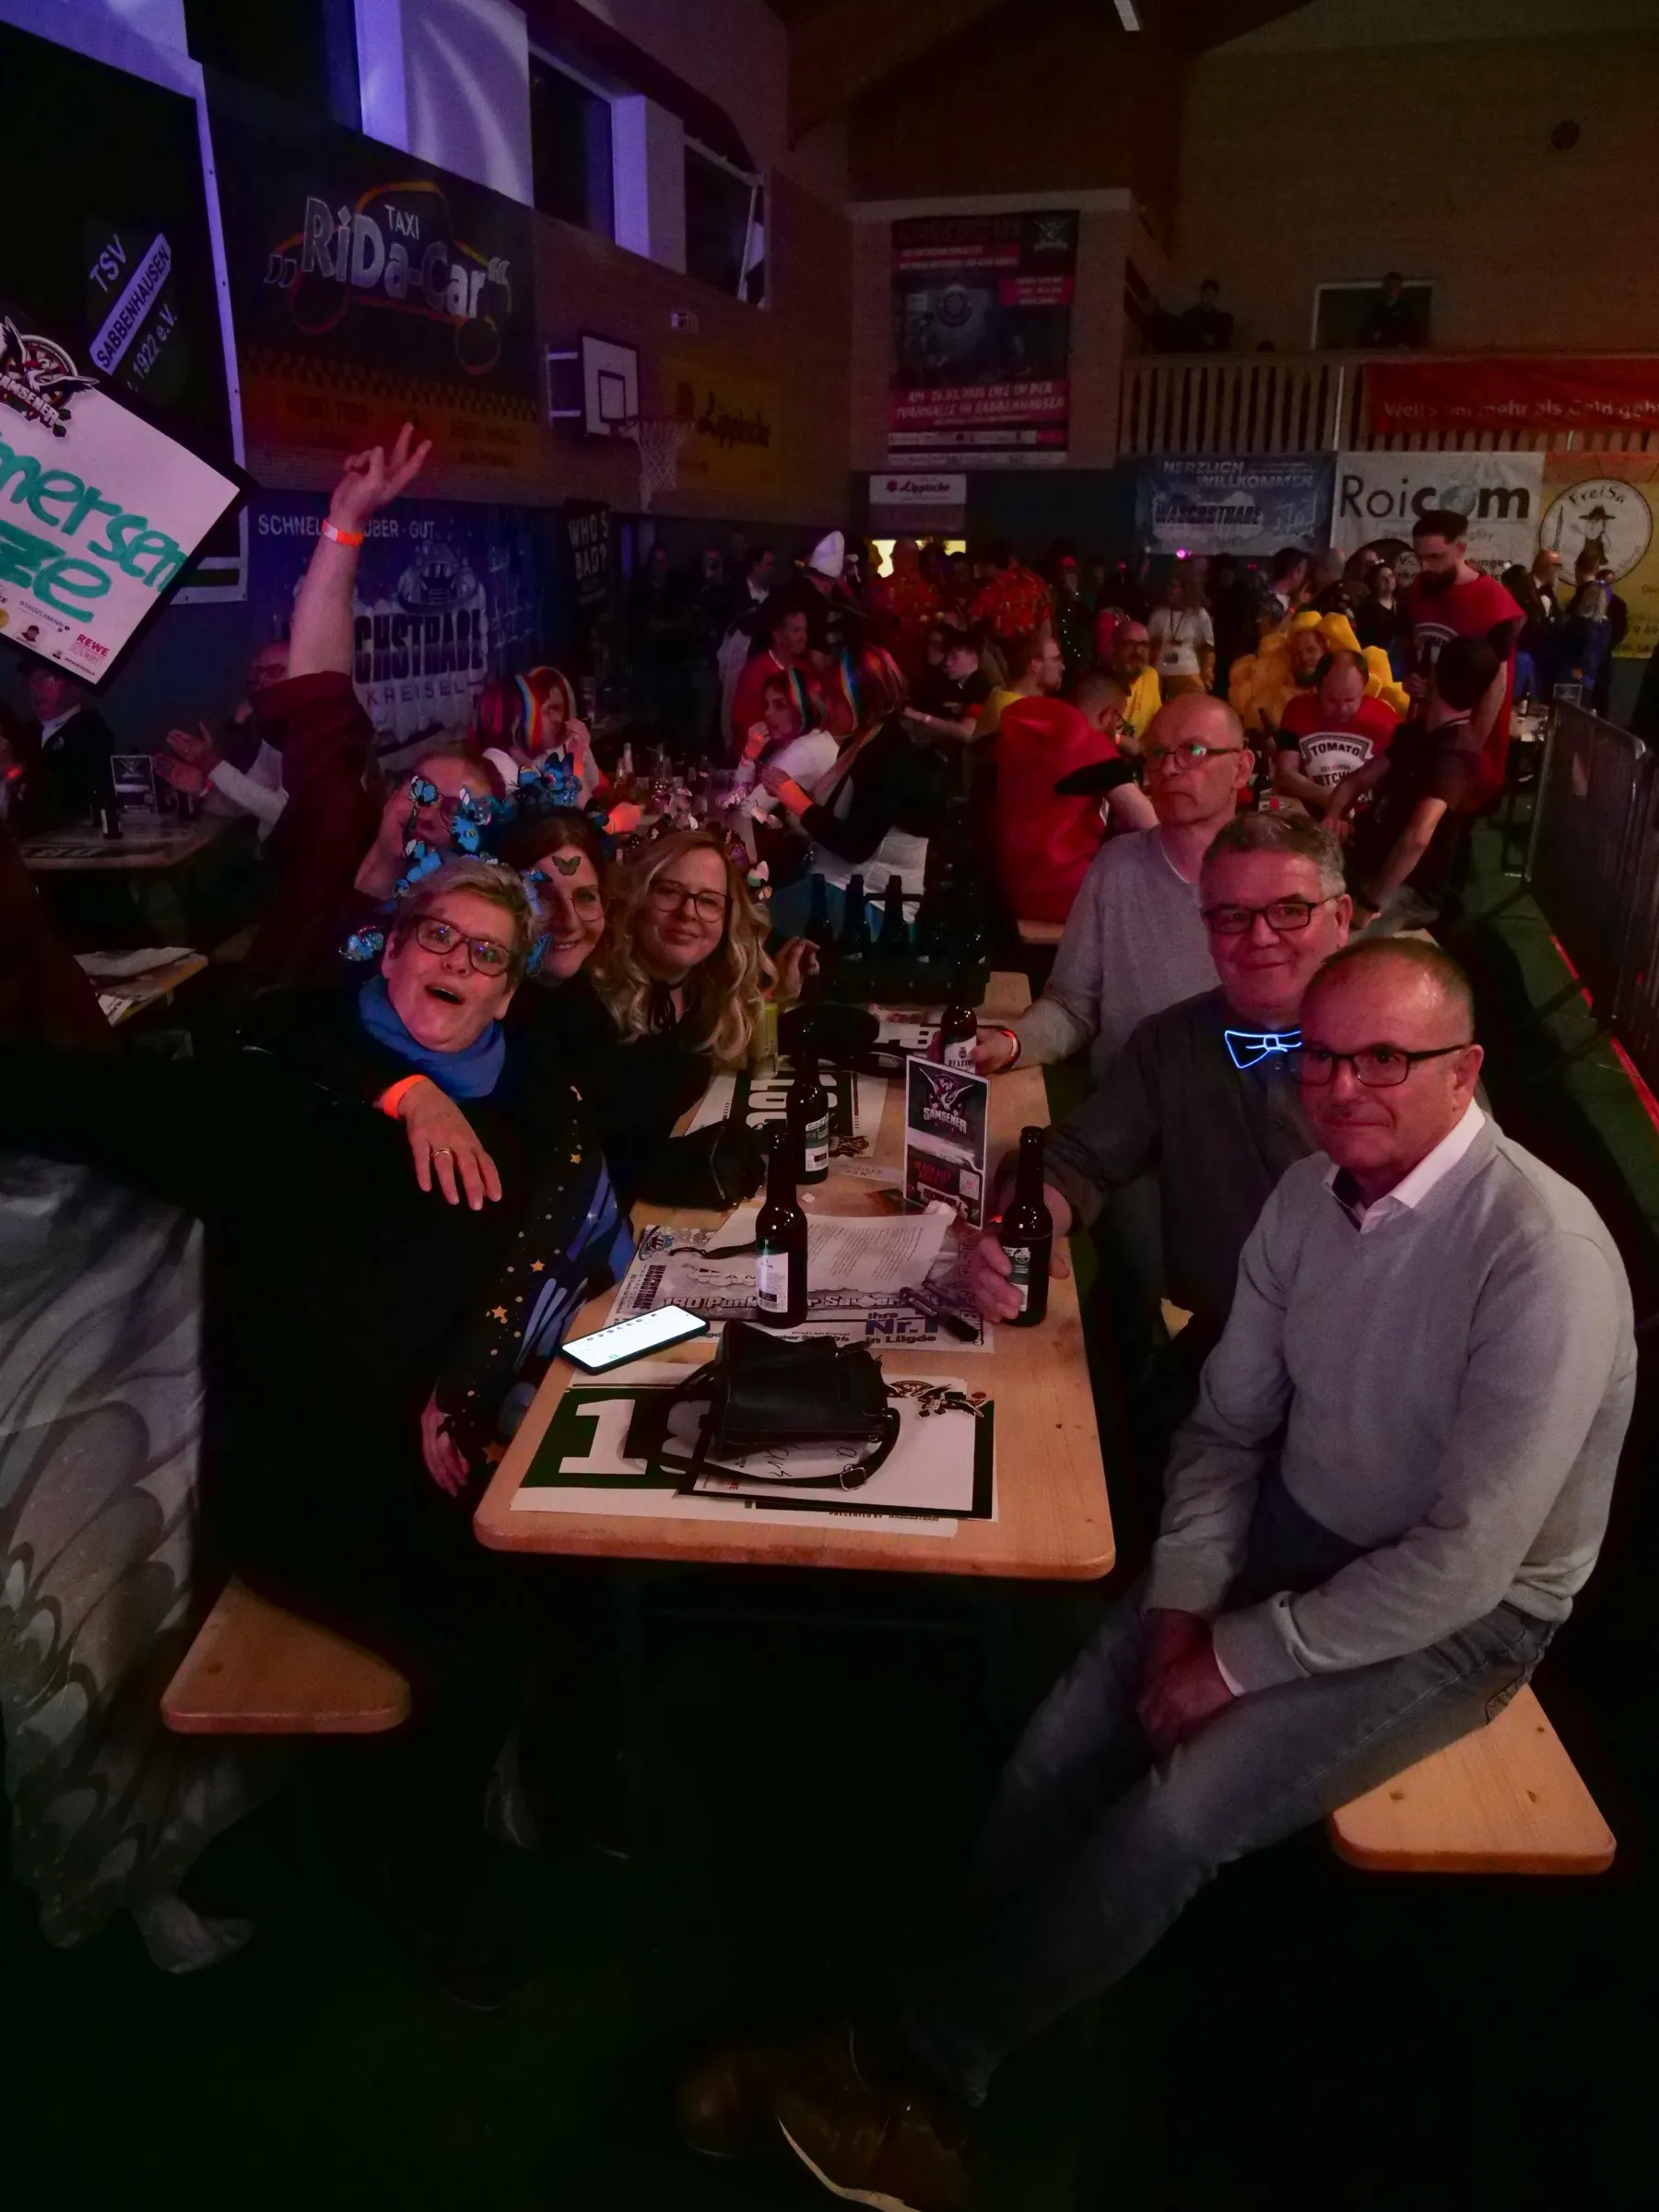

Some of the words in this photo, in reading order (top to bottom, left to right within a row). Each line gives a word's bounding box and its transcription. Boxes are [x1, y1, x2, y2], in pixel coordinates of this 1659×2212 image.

[383, 204, 420, 241] TAXI
[88, 232, 127, 292] TSV
[97, 245, 170, 369] SABBENHAUSEN
[133, 333, 162, 380] 1922
[0, 372, 65, 428] AMSENER
[1163, 461, 1244, 475] HERZLICH
[1195, 474, 1314, 489] WILLKOMMEN
[257, 513, 323, 537] SCHNEL
[362, 520, 400, 539] UBER
[409, 521, 436, 540] GUT
[76, 633, 110, 657] REWE
[368, 680, 466, 707] KREISEL
[1310, 742, 1360, 757] TOMATO
[948, 1059, 975, 1067] VELTIN
[923, 1107, 967, 1135] SAMSENER
[707, 1296, 758, 1309] Punk
[886, 1335, 937, 1345] Lügde
